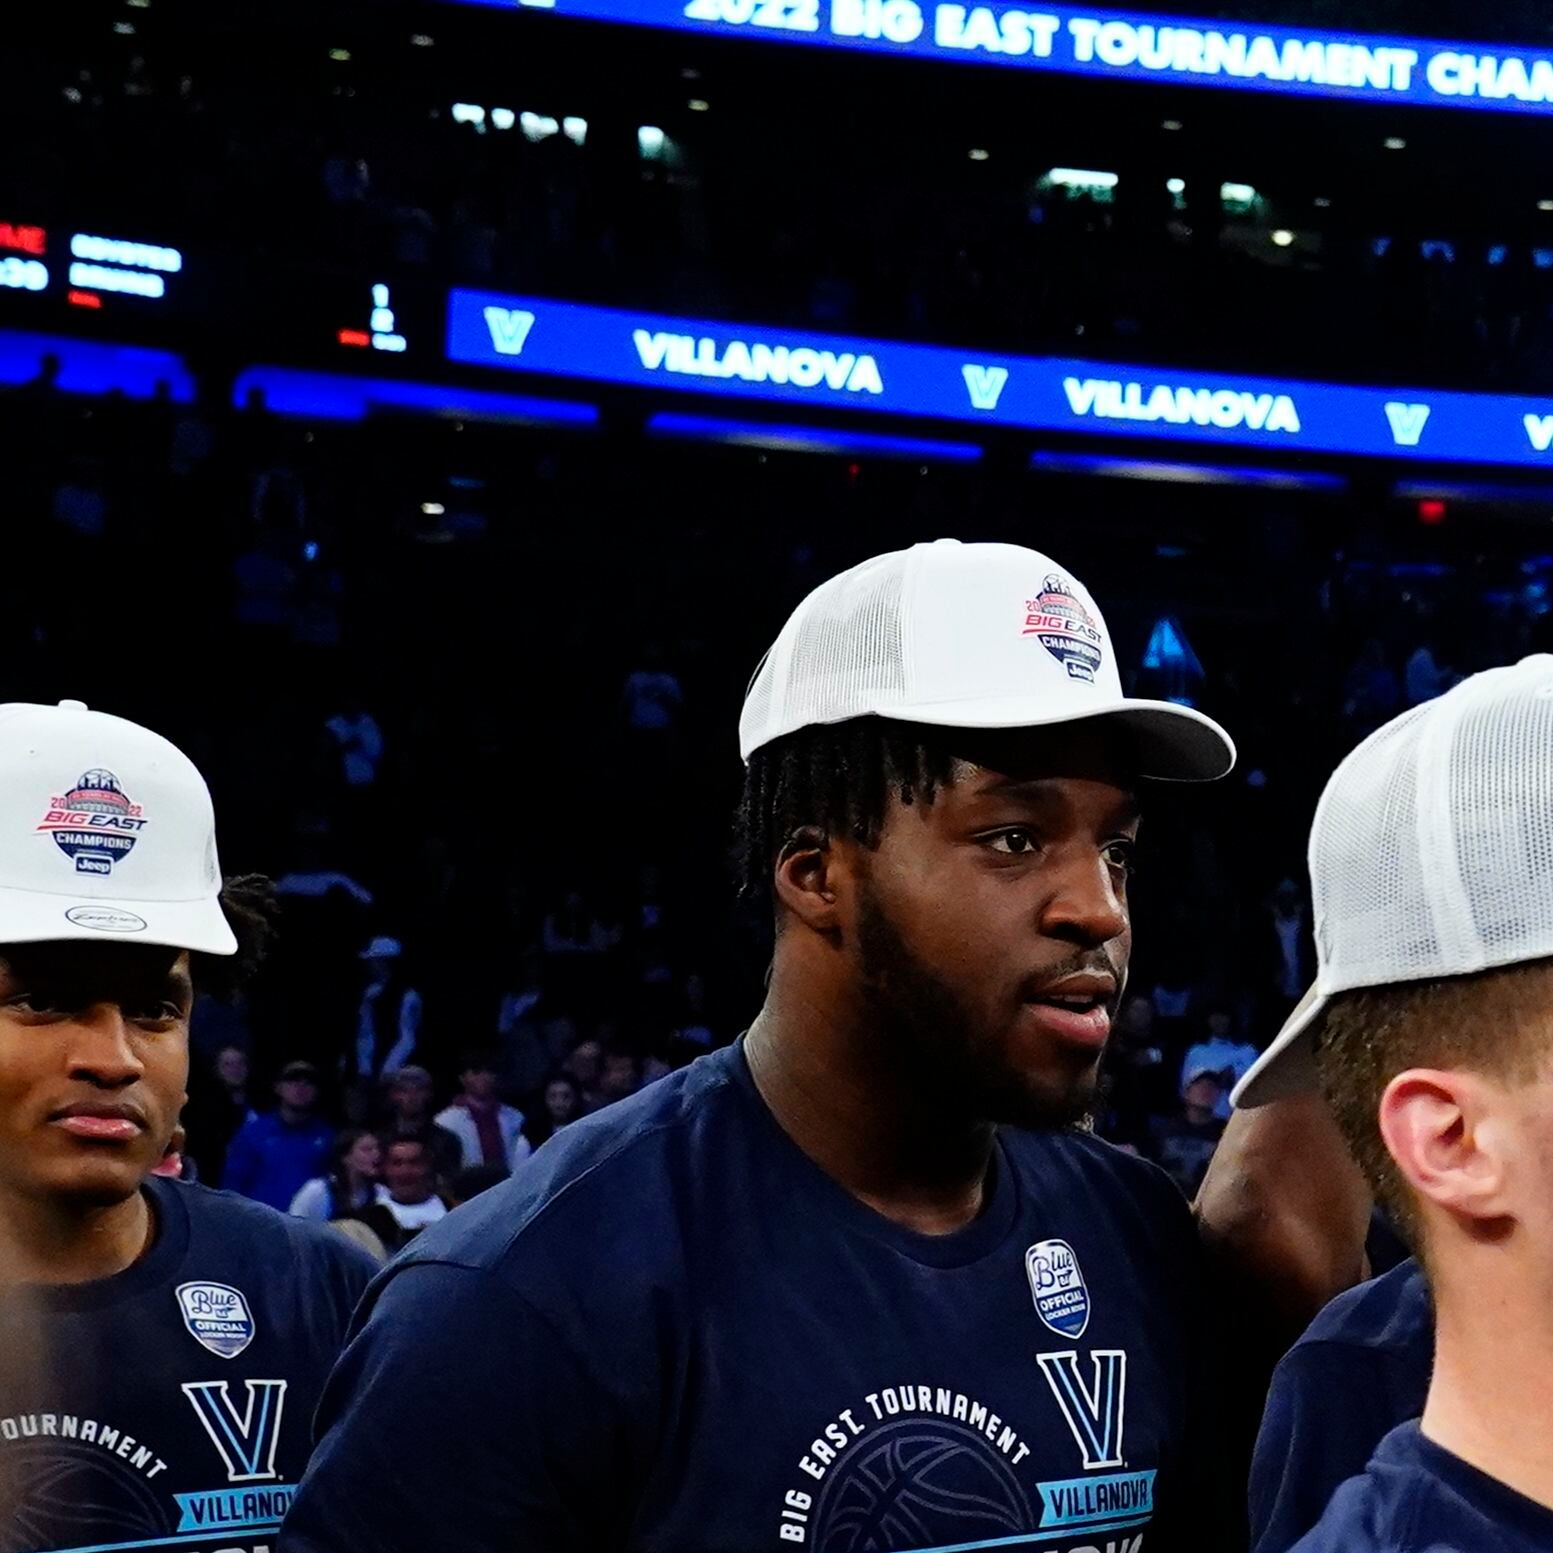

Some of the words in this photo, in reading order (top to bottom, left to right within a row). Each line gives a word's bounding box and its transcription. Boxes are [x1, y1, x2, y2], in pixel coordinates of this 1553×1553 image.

[831, 0, 923, 43] BIG
[935, 3, 1055, 60] EAST
[1070, 18, 1418, 94] TOURNAMENT
[483, 306, 535, 355] V
[633, 329, 884, 395] VILLANOVA
[962, 364, 1009, 410] V
[1063, 377, 1300, 434] VILLANOVA
[1385, 402, 1431, 446] V
[1025, 614, 1064, 628] BIG
[1064, 620, 1103, 643] EAST
[44, 810, 89, 825] BIG
[88, 814, 149, 831] EAST
[56, 831, 132, 850] CHAMPIONS
[1032, 1251, 1073, 1291] Blue
[191, 1289, 238, 1314] Blue
[1040, 1290, 1085, 1312] OFFICIAL
[1035, 1349, 1128, 1471] V
[181, 1379, 287, 1482] V
[780, 1489, 811, 1544] BIG
[799, 1407, 867, 1481] EAST
[865, 1384, 1032, 1466] TOURNAMENT
[1049, 1481, 1149, 1518] VILLANOVA
